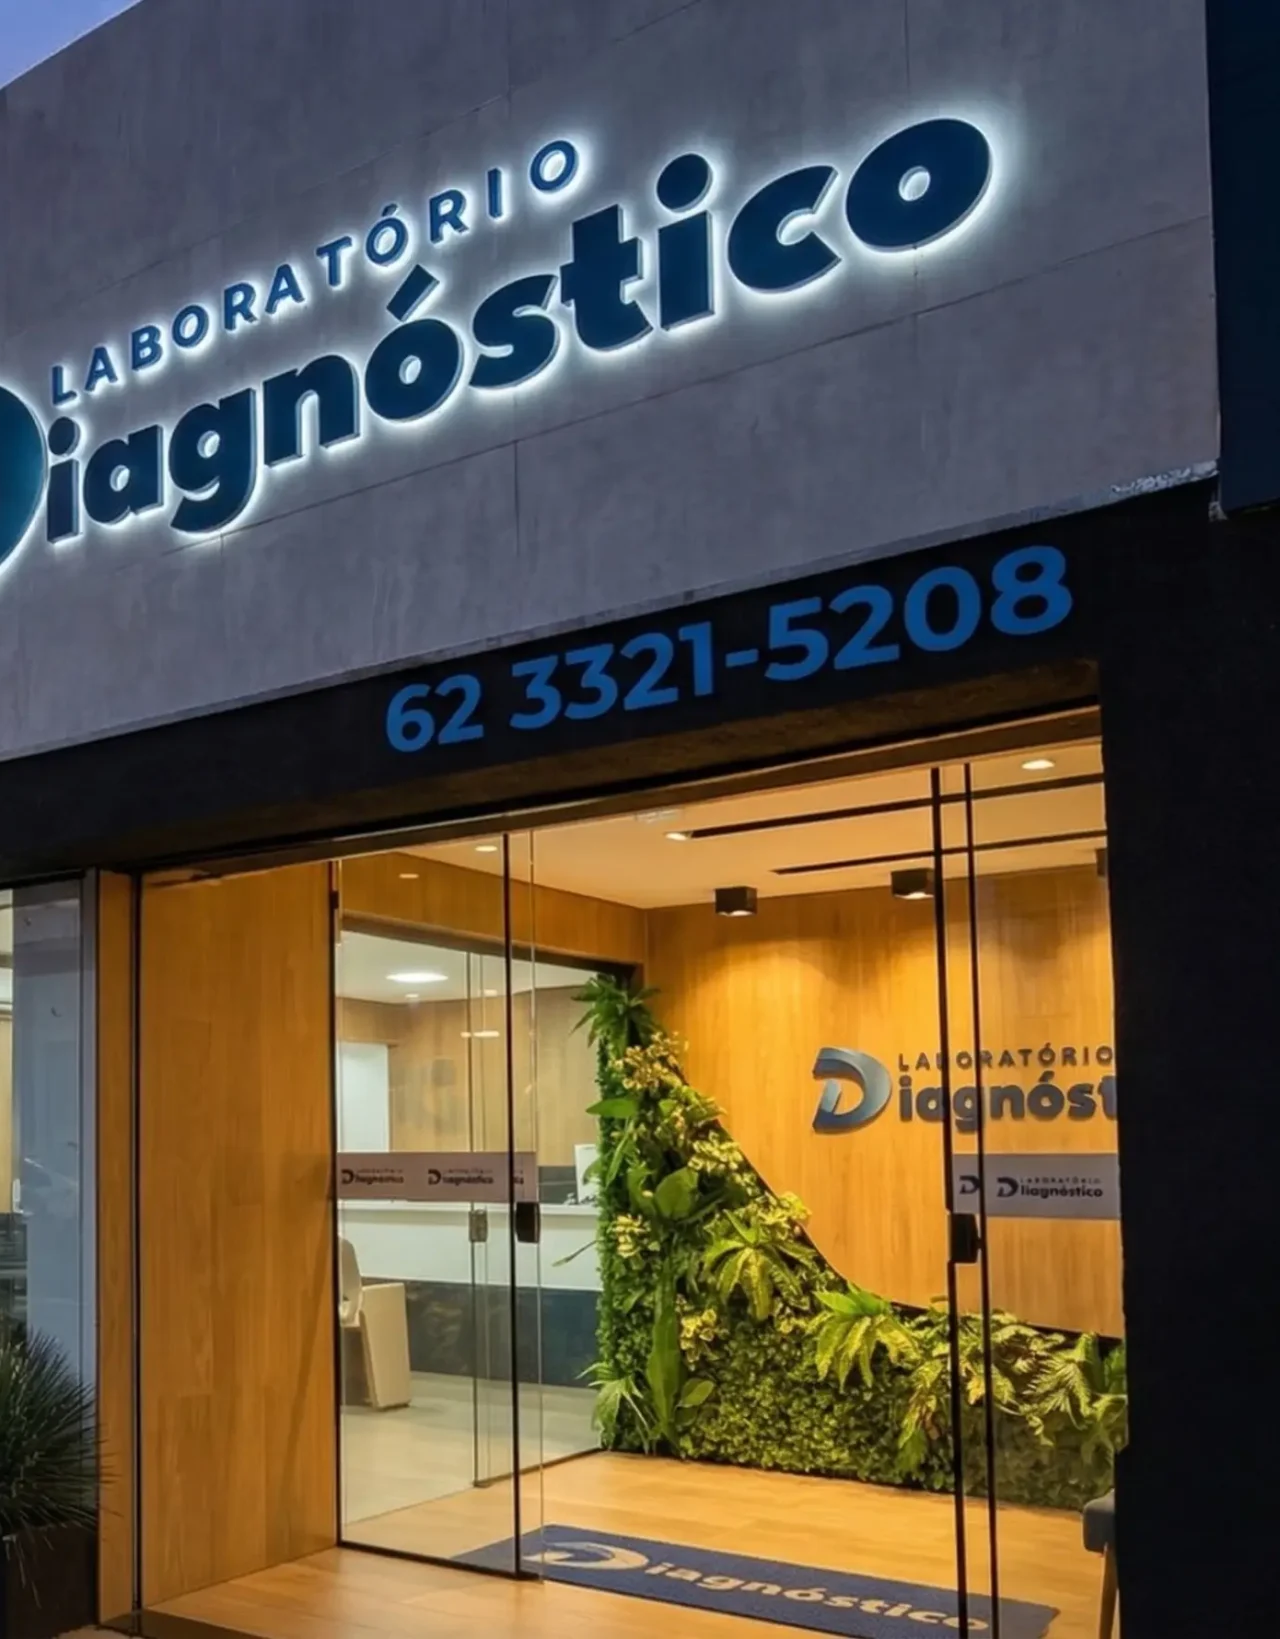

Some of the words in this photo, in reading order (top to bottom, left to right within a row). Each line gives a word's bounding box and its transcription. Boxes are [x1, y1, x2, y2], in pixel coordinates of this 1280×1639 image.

[51, 139, 579, 405] LABORATÓRIO
[385, 673, 484, 753] 62
[509, 545, 1073, 730] 3321-5208
[522, 1541, 989, 1630] Diagnóstico
